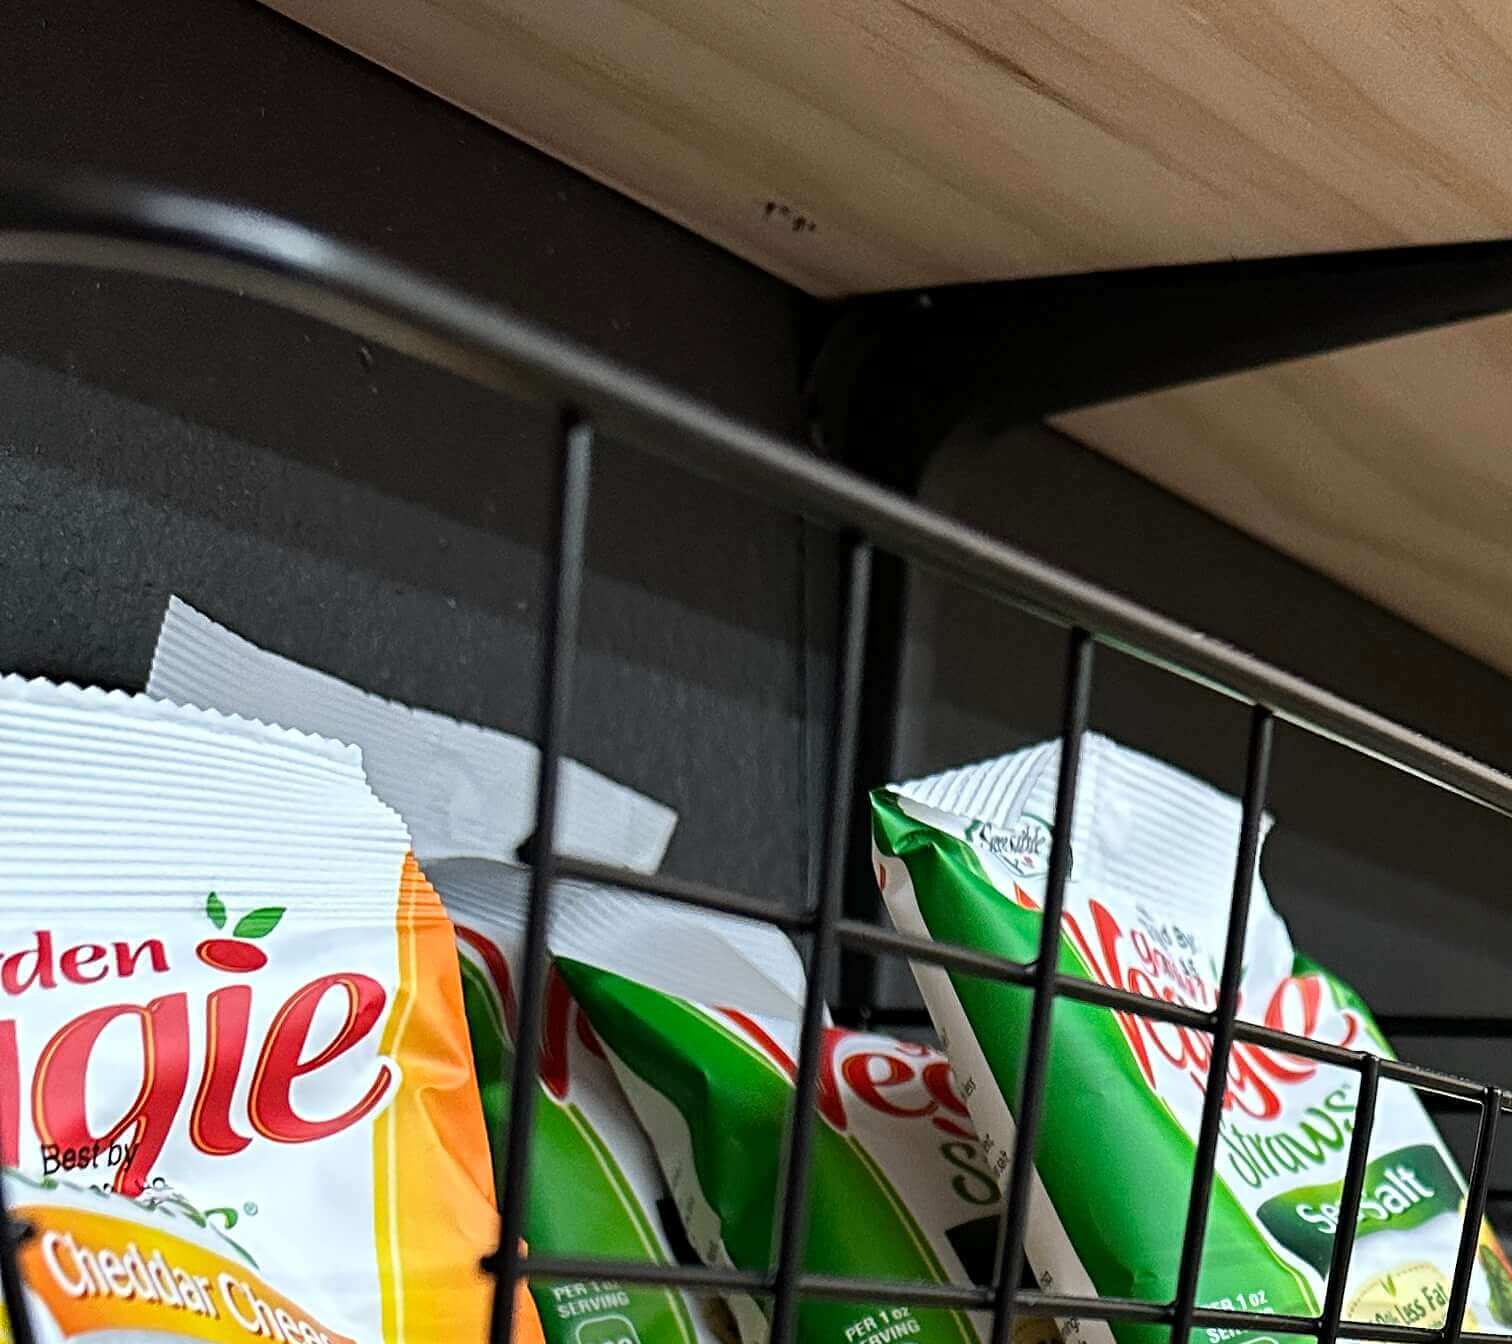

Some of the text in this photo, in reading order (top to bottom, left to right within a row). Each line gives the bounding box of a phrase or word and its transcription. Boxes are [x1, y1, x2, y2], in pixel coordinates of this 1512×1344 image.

[0, 930, 170, 996] den
[40, 1143, 100, 1176] Best
[42, 1231, 218, 1319] Cheddar
[552, 1283, 587, 1302] PER
[557, 1290, 631, 1319] SERVING
[845, 1305, 911, 1343] PER 1 oz
